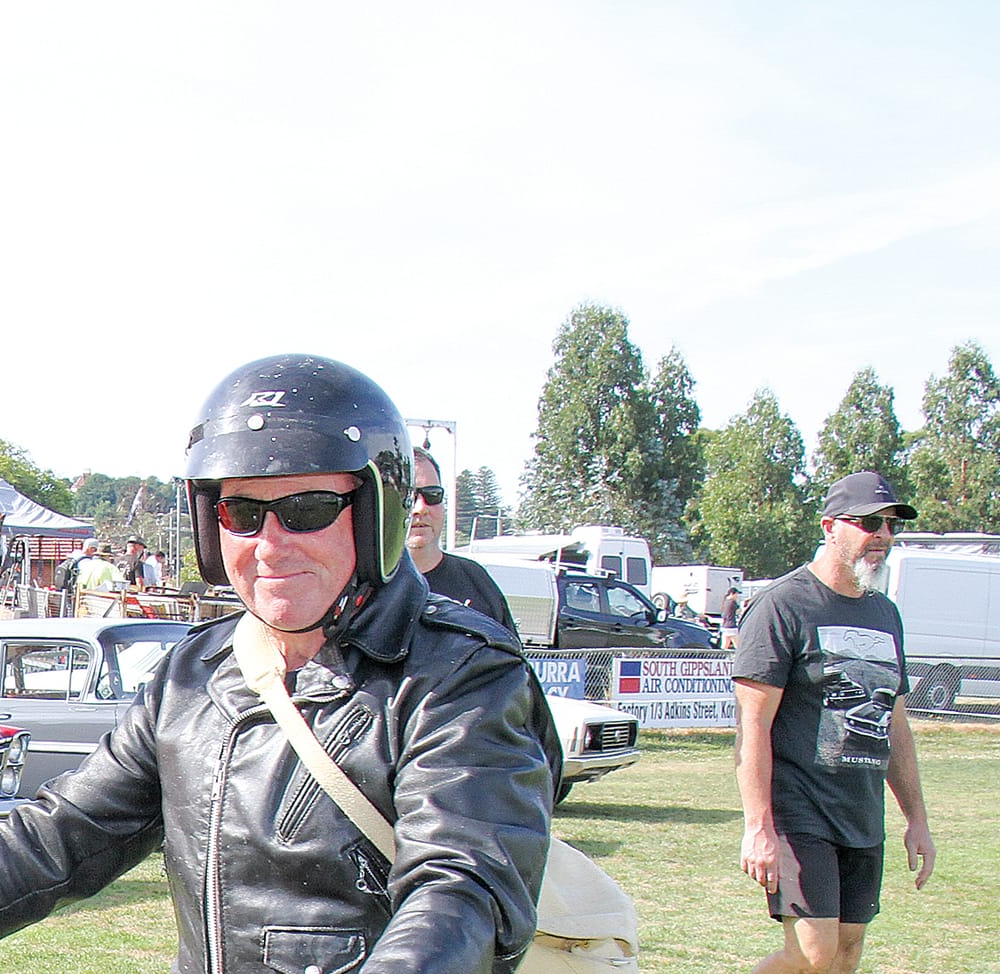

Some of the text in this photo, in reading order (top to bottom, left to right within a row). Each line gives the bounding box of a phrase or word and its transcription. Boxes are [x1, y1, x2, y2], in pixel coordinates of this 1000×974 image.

[529, 661, 580, 683] URRA
[642, 661, 677, 677] SOUTH
[642, 678, 662, 693] AIR
[651, 702, 663, 719] 1/3
[664, 702, 691, 719] Adkins
[693, 702, 719, 722] Street,
